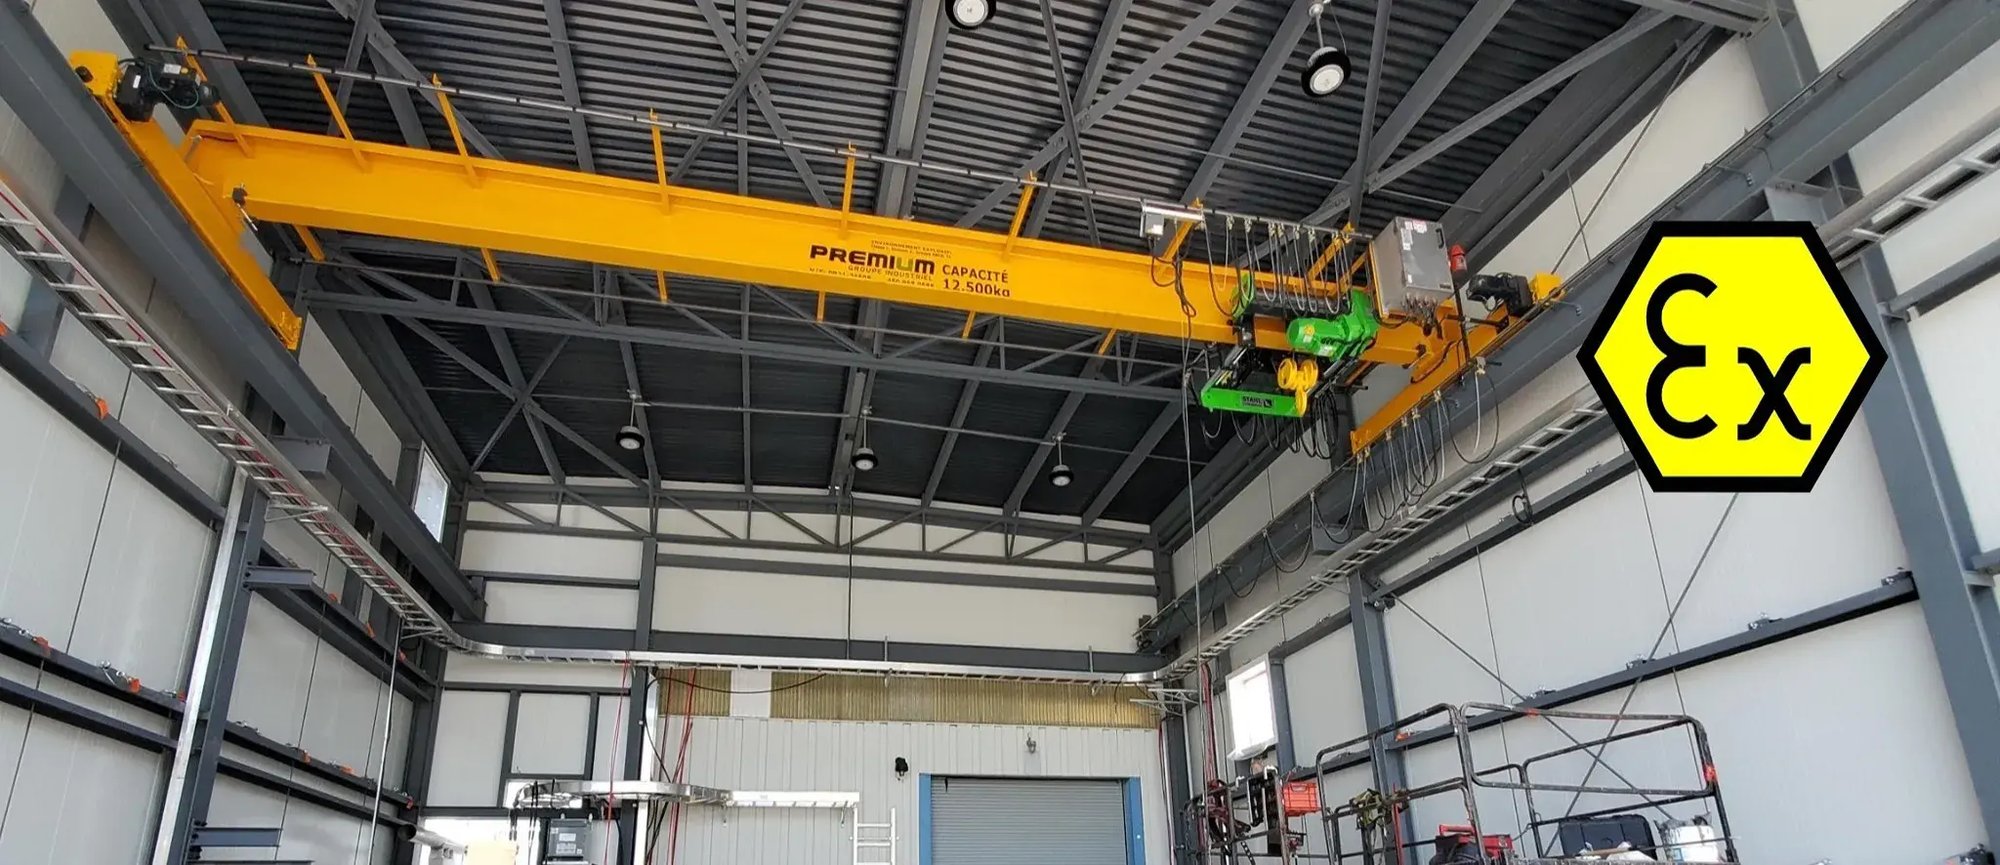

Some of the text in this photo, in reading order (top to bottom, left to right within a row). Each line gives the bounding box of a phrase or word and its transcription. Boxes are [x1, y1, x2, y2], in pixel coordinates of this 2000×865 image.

[810, 244, 935, 275] PREMIUM
[848, 265, 882, 275] GROUPE
[885, 270, 933, 281] INDUSTRIEL
[942, 264, 1009, 283] CAPACITÉ
